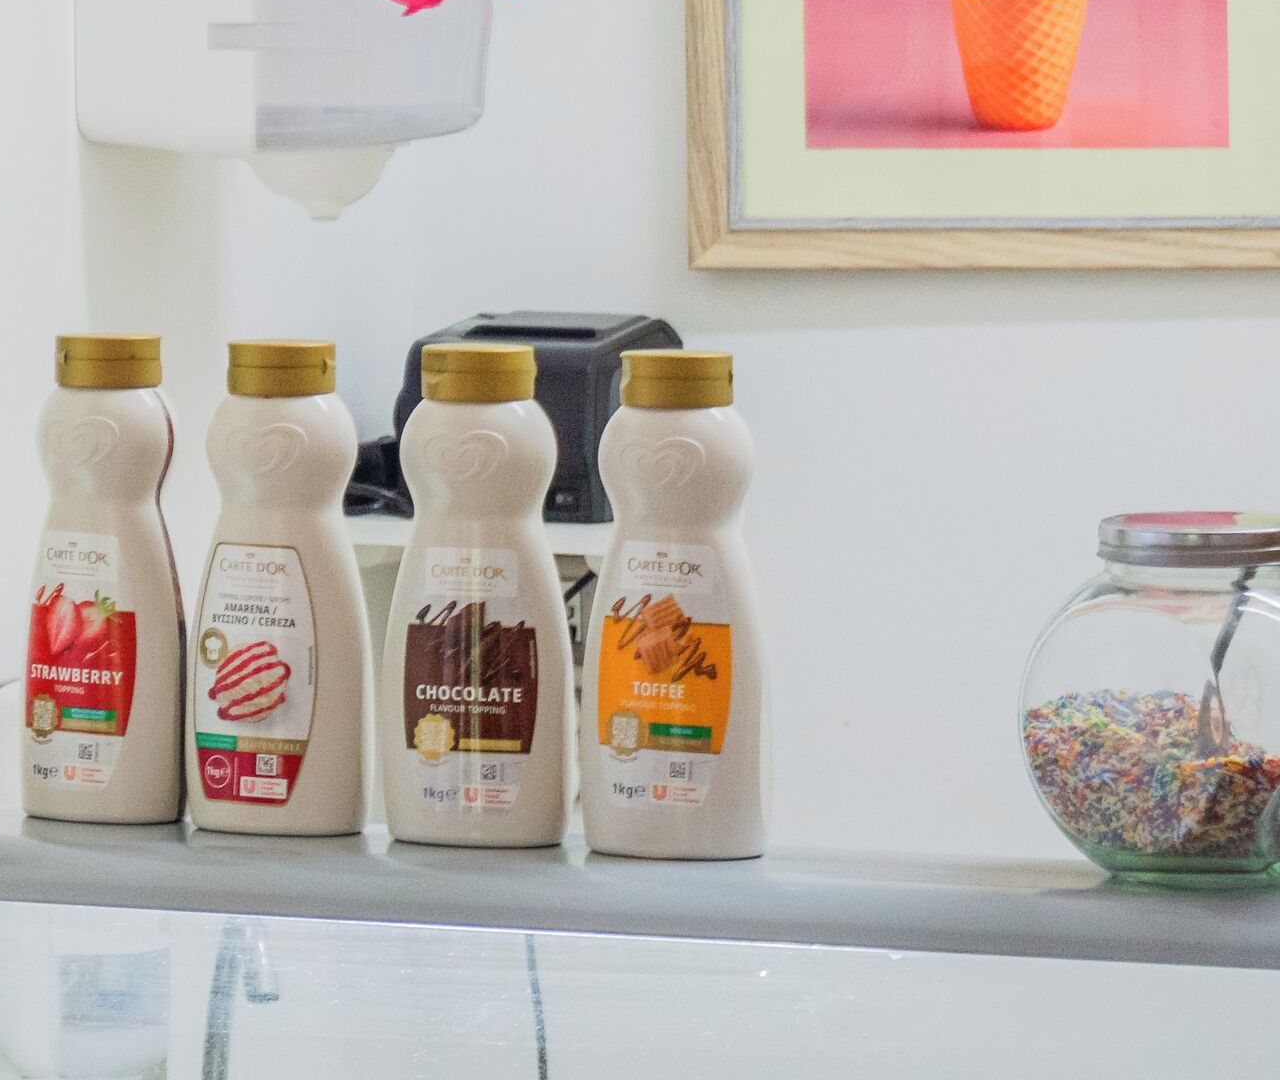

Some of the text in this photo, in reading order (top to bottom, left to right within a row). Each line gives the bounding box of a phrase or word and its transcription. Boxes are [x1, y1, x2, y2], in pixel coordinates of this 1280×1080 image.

[47, 548, 74, 561] CARTE
[223, 602, 270, 616] AMARENA
[258, 616, 296, 628] CEREZA
[31, 664, 124, 686] STRAWBERRY
[54, 684, 86, 696] TOPPING
[416, 684, 522, 704] CHOCOLATE
[632, 680, 684, 700] TOFFEE
[430, 704, 506, 715] FLAVOUR TOPPING
